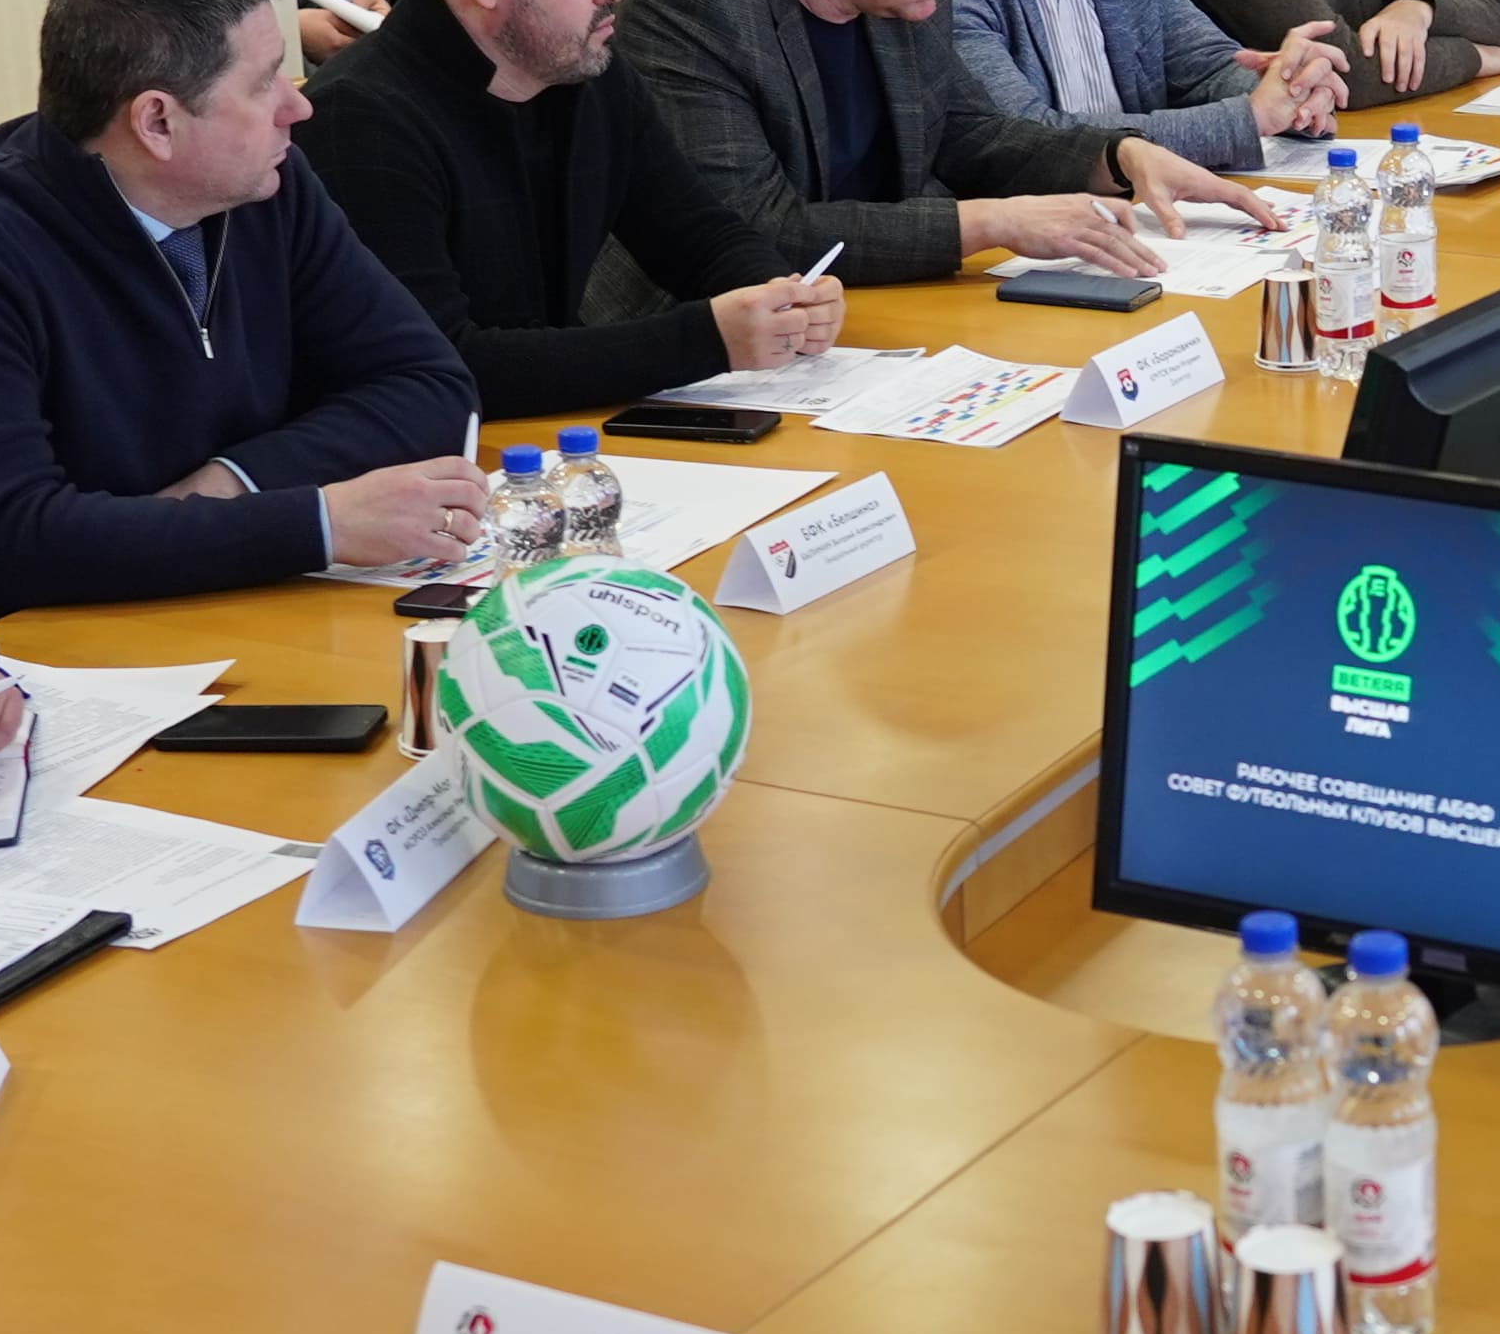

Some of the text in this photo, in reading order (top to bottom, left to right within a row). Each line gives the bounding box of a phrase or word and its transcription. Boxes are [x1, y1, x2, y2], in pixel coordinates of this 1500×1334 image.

[799, 519, 827, 541] БФК
[588, 587, 683, 635] uhlsport
[1339, 672, 1405, 693] BETERA
[1330, 693, 1411, 723] ВЫСШАЯ
[1344, 714, 1392, 740] ЛИГА
[1167, 772, 1225, 799] СОВЕТ
[1225, 782, 1350, 822] ФУТБОЛЬНЫХ
[1350, 804, 1425, 835] КЛУБОВ
[1236, 761, 1496, 825] РАБОЧЕЕ СОВЕЩАНИЕ АБФФ
